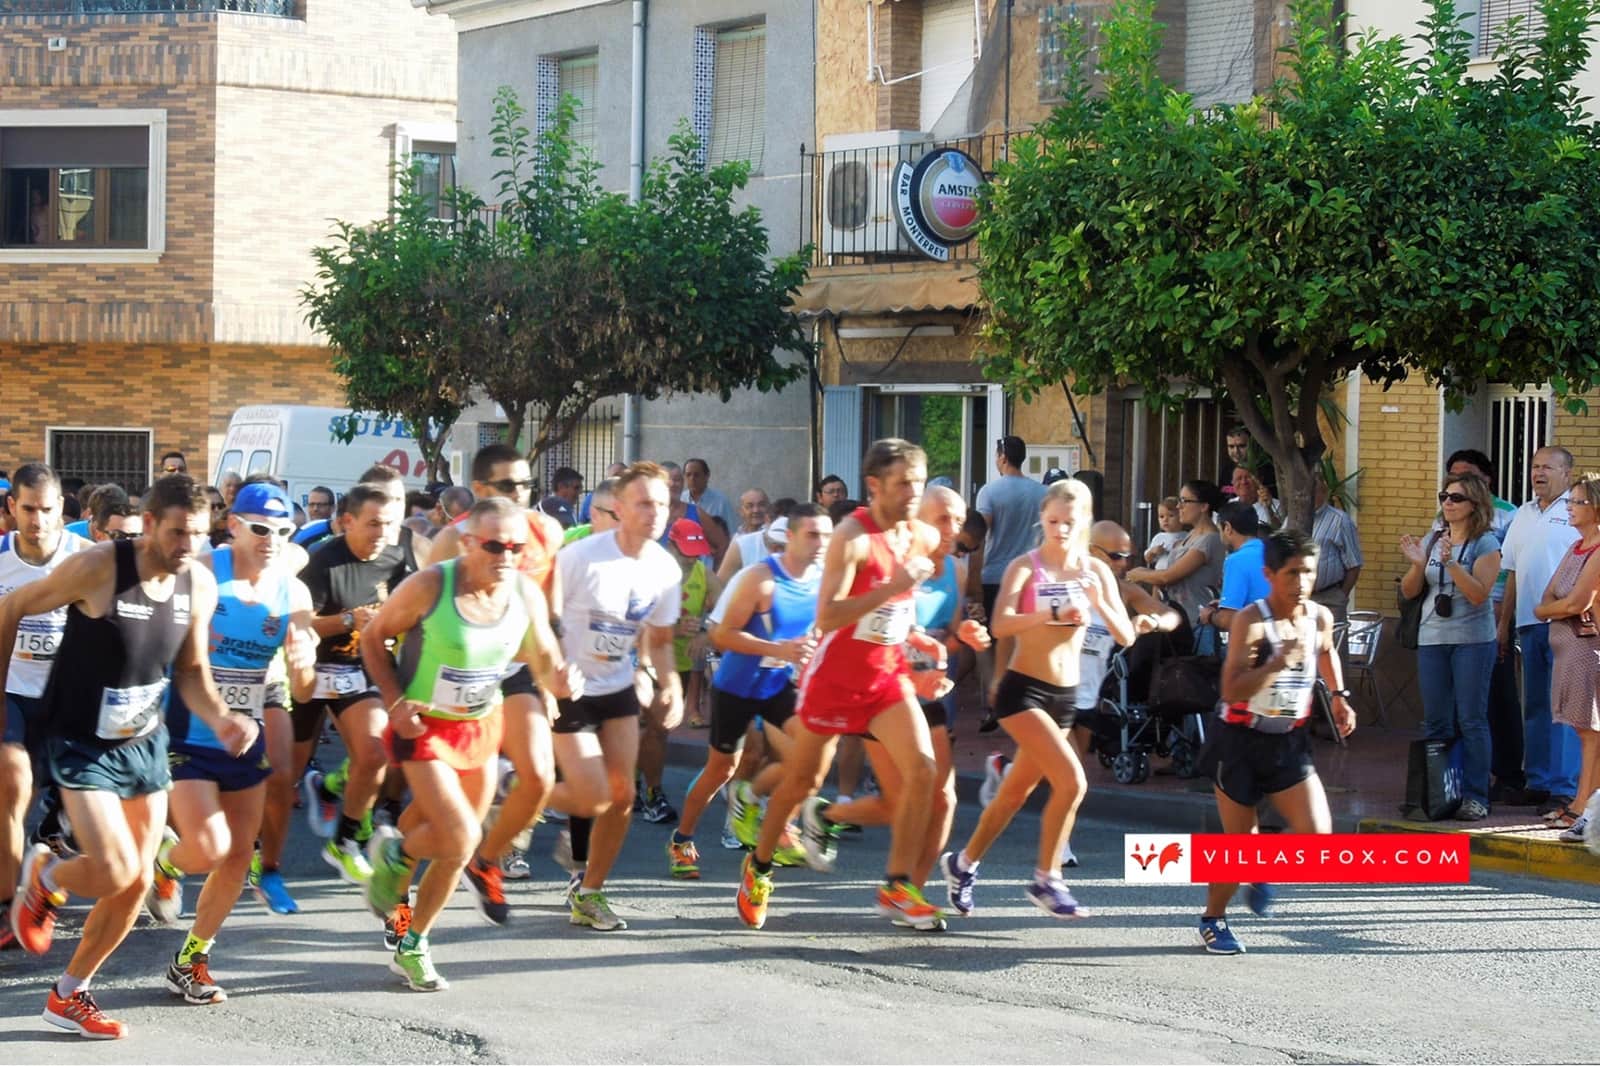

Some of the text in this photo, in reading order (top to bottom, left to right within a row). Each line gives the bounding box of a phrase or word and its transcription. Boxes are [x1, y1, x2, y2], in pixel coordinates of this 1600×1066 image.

[900, 173, 945, 258] BAR MONTERREY
[18, 633, 55, 652] 156
